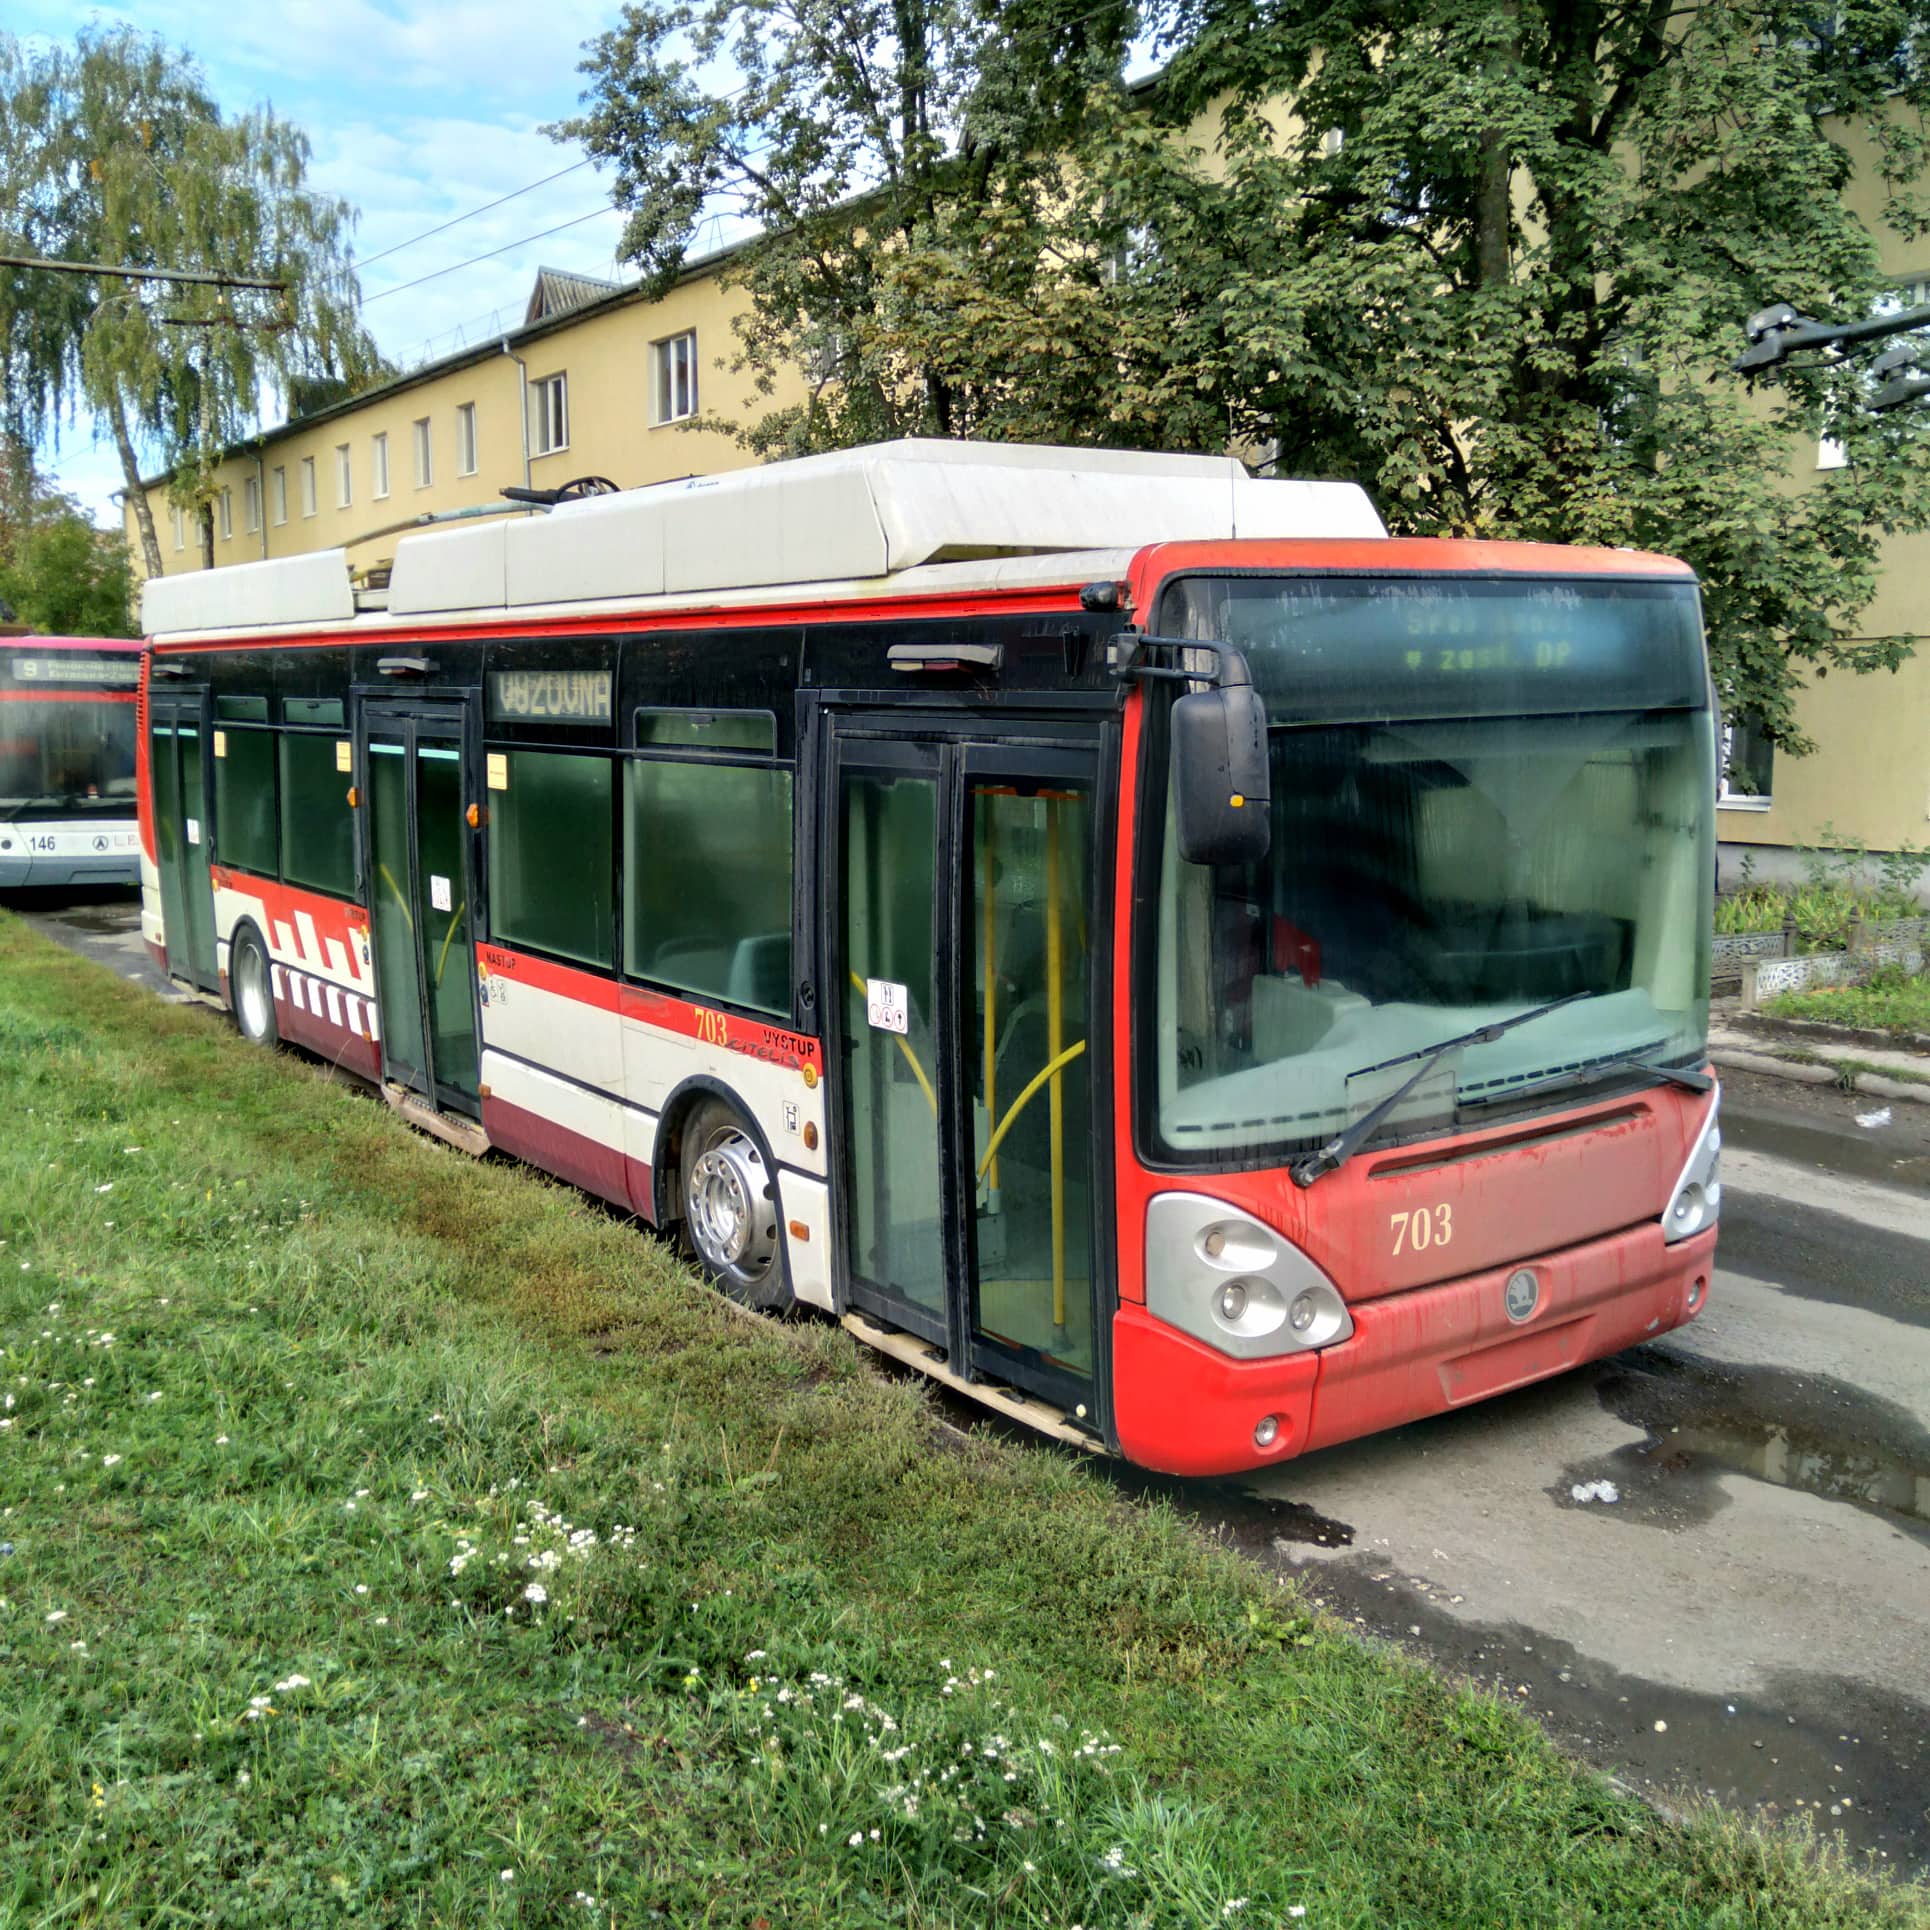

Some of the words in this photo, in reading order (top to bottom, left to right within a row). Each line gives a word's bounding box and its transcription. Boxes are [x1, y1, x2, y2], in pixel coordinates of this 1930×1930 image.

[23, 661, 38, 677] 9
[30, 836, 56, 851] 146
[694, 1007, 728, 1047] 703
[1391, 1203, 1452, 1256] 703
